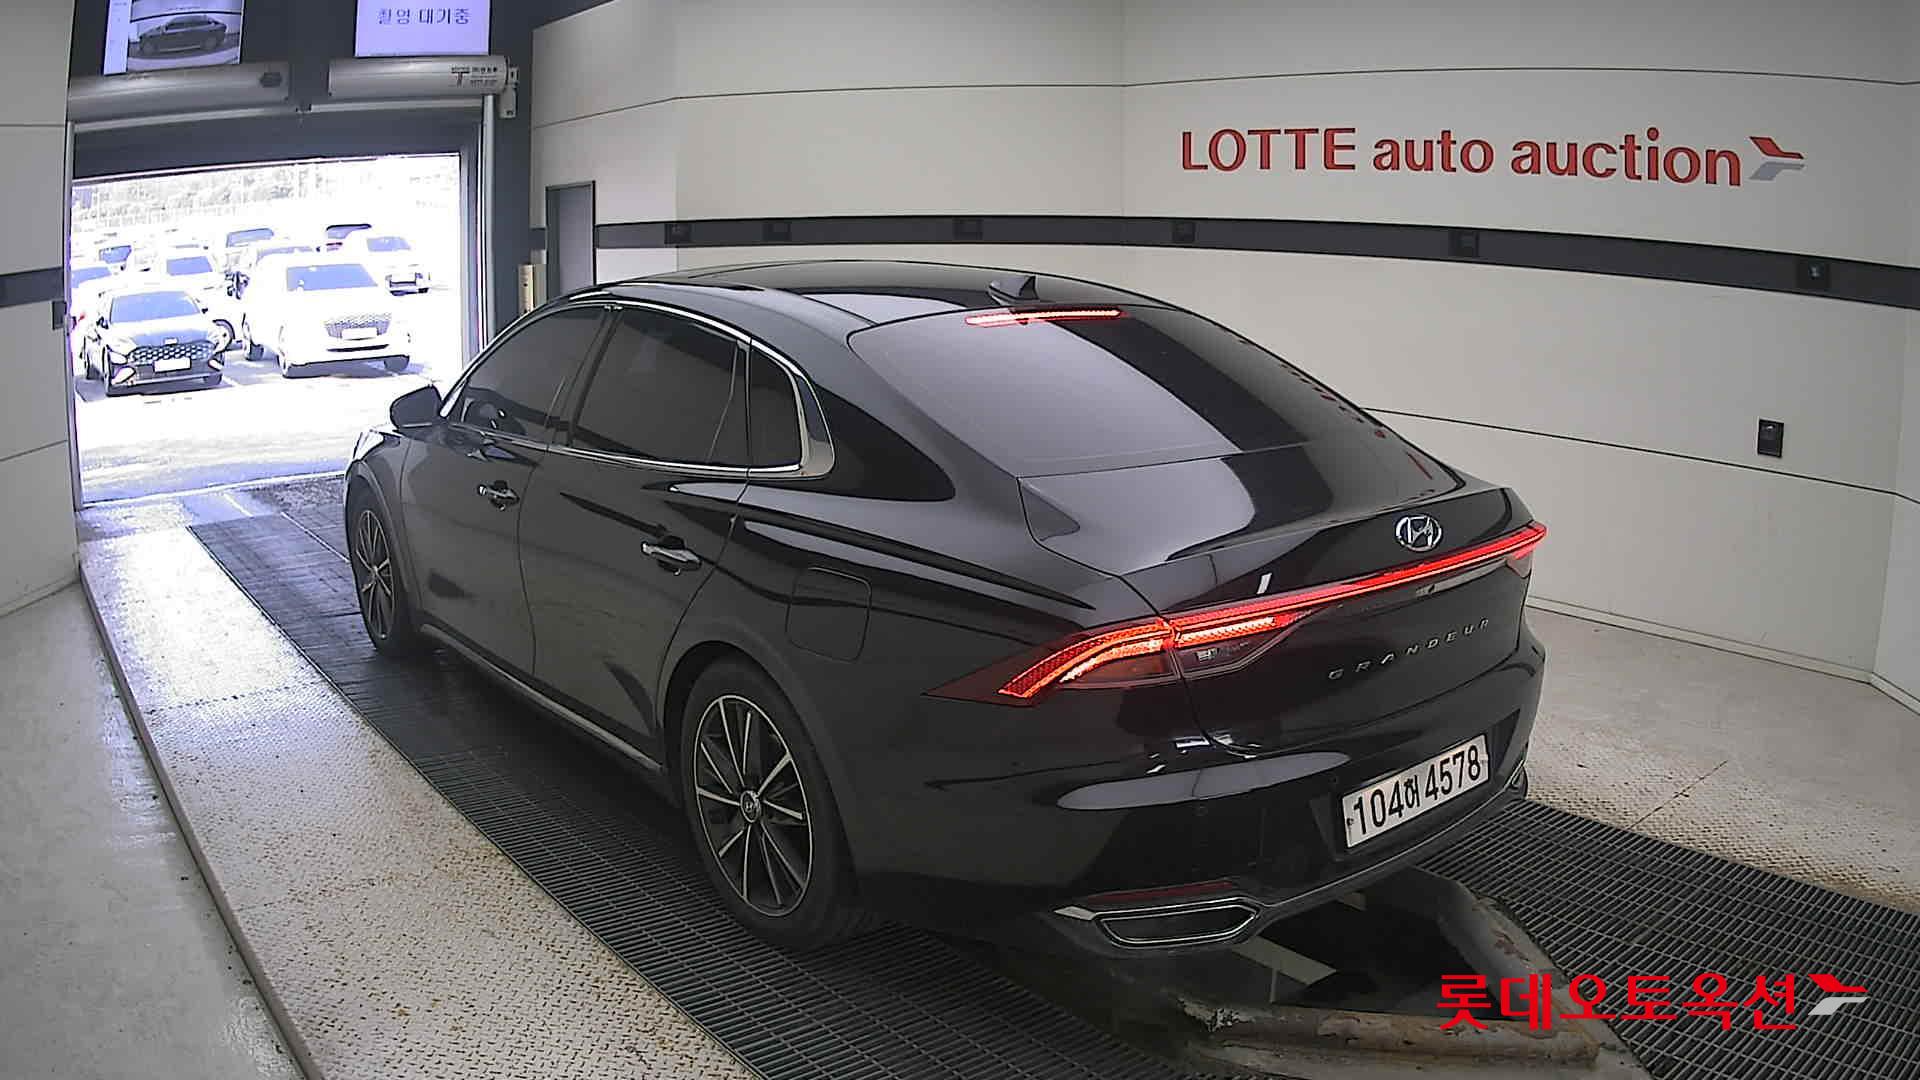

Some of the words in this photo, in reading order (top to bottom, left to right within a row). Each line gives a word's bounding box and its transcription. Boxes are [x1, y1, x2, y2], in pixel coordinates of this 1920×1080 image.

[418, 8, 471, 25] 대기중
[1181, 127, 1356, 172] LOTTE
[1373, 129, 1494, 173] auto
[1510, 127, 1742, 188] auction
[1328, 616, 1489, 680] GRANDEUR
[1353, 774, 1421, 835] 104허
[1424, 745, 1481, 801] 4578
